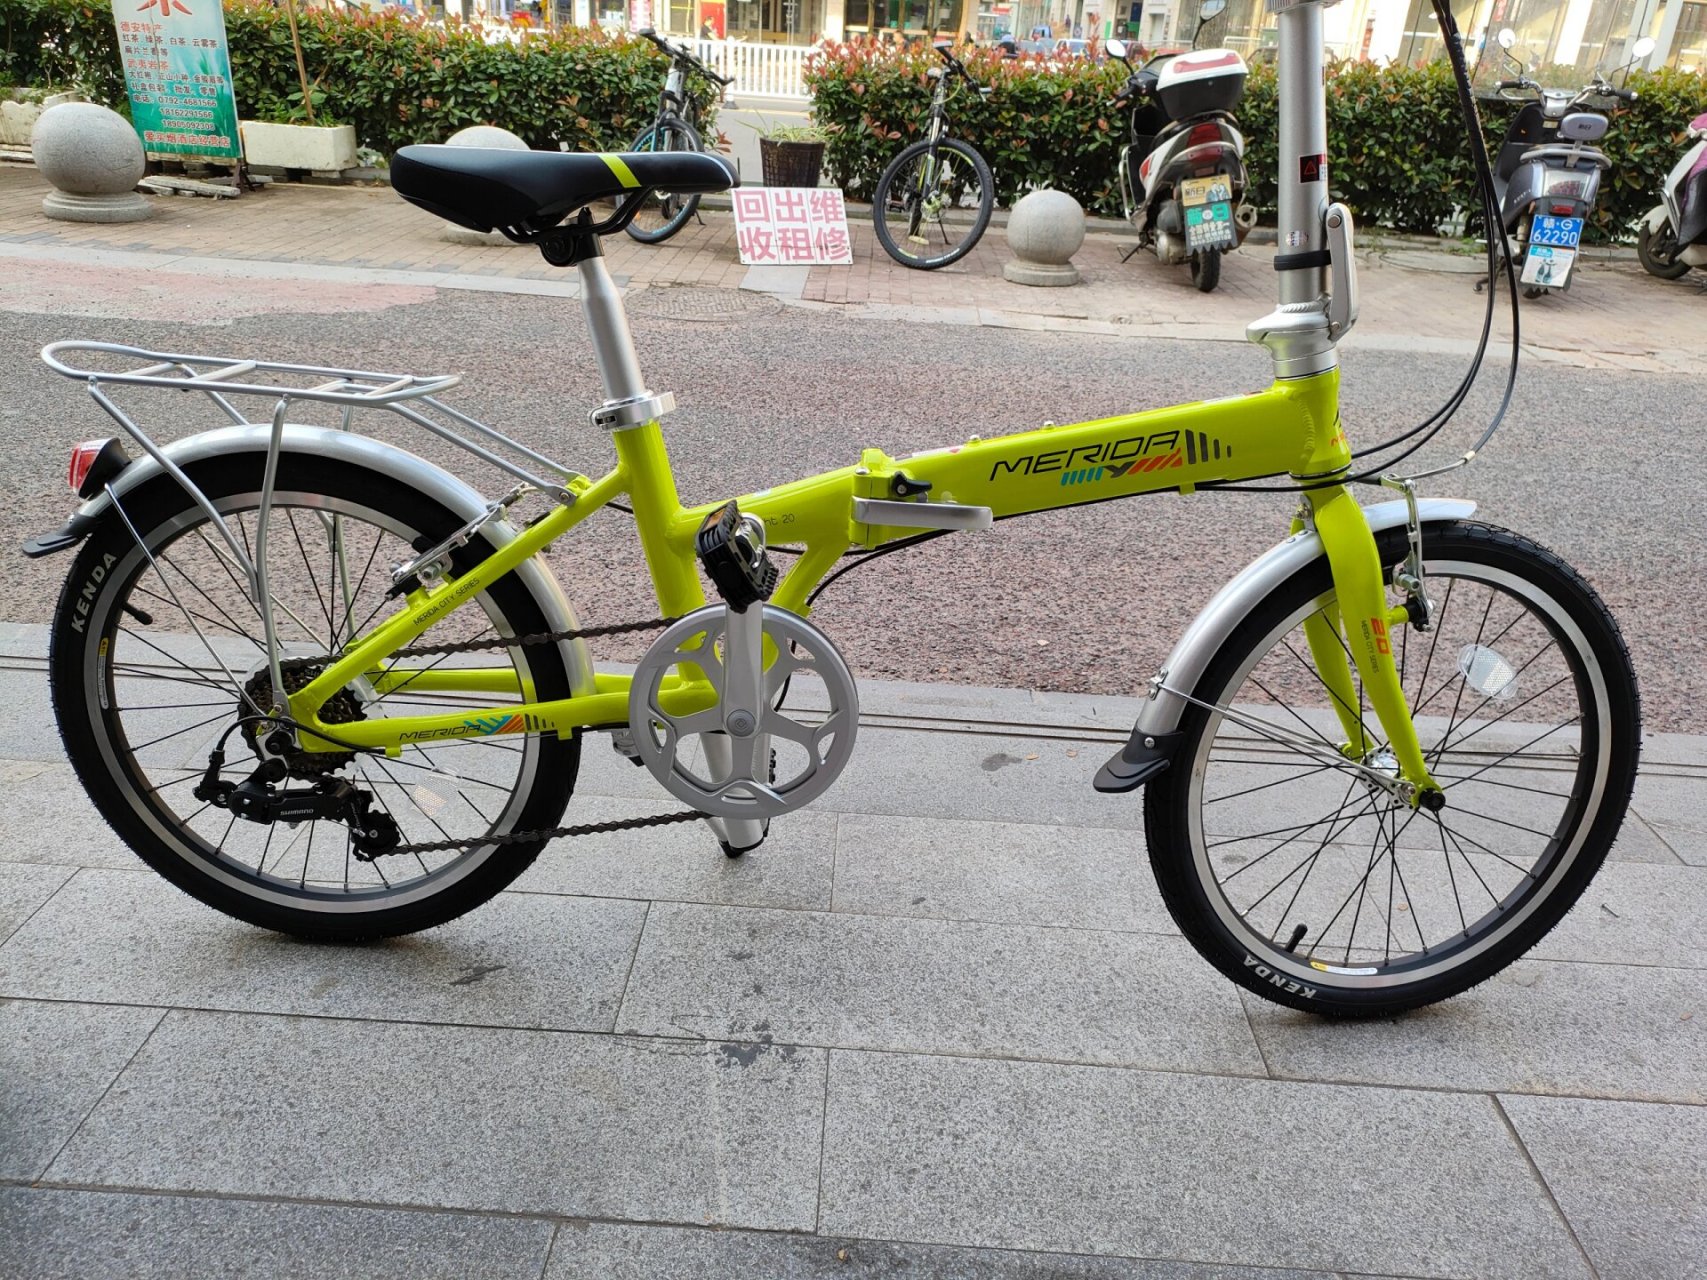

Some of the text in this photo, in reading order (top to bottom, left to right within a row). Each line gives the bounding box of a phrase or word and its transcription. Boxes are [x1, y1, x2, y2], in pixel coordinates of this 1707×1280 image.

[1533, 229, 1578, 245] 62290
[990, 430, 1181, 481] MERIDA
[71, 552, 117, 633] KENDA
[413, 577, 480, 626] MERIDA CITY SERIES
[1371, 617, 1390, 654] 20
[400, 725, 481, 741] MERIDA
[1242, 954, 1317, 999] KENDA
